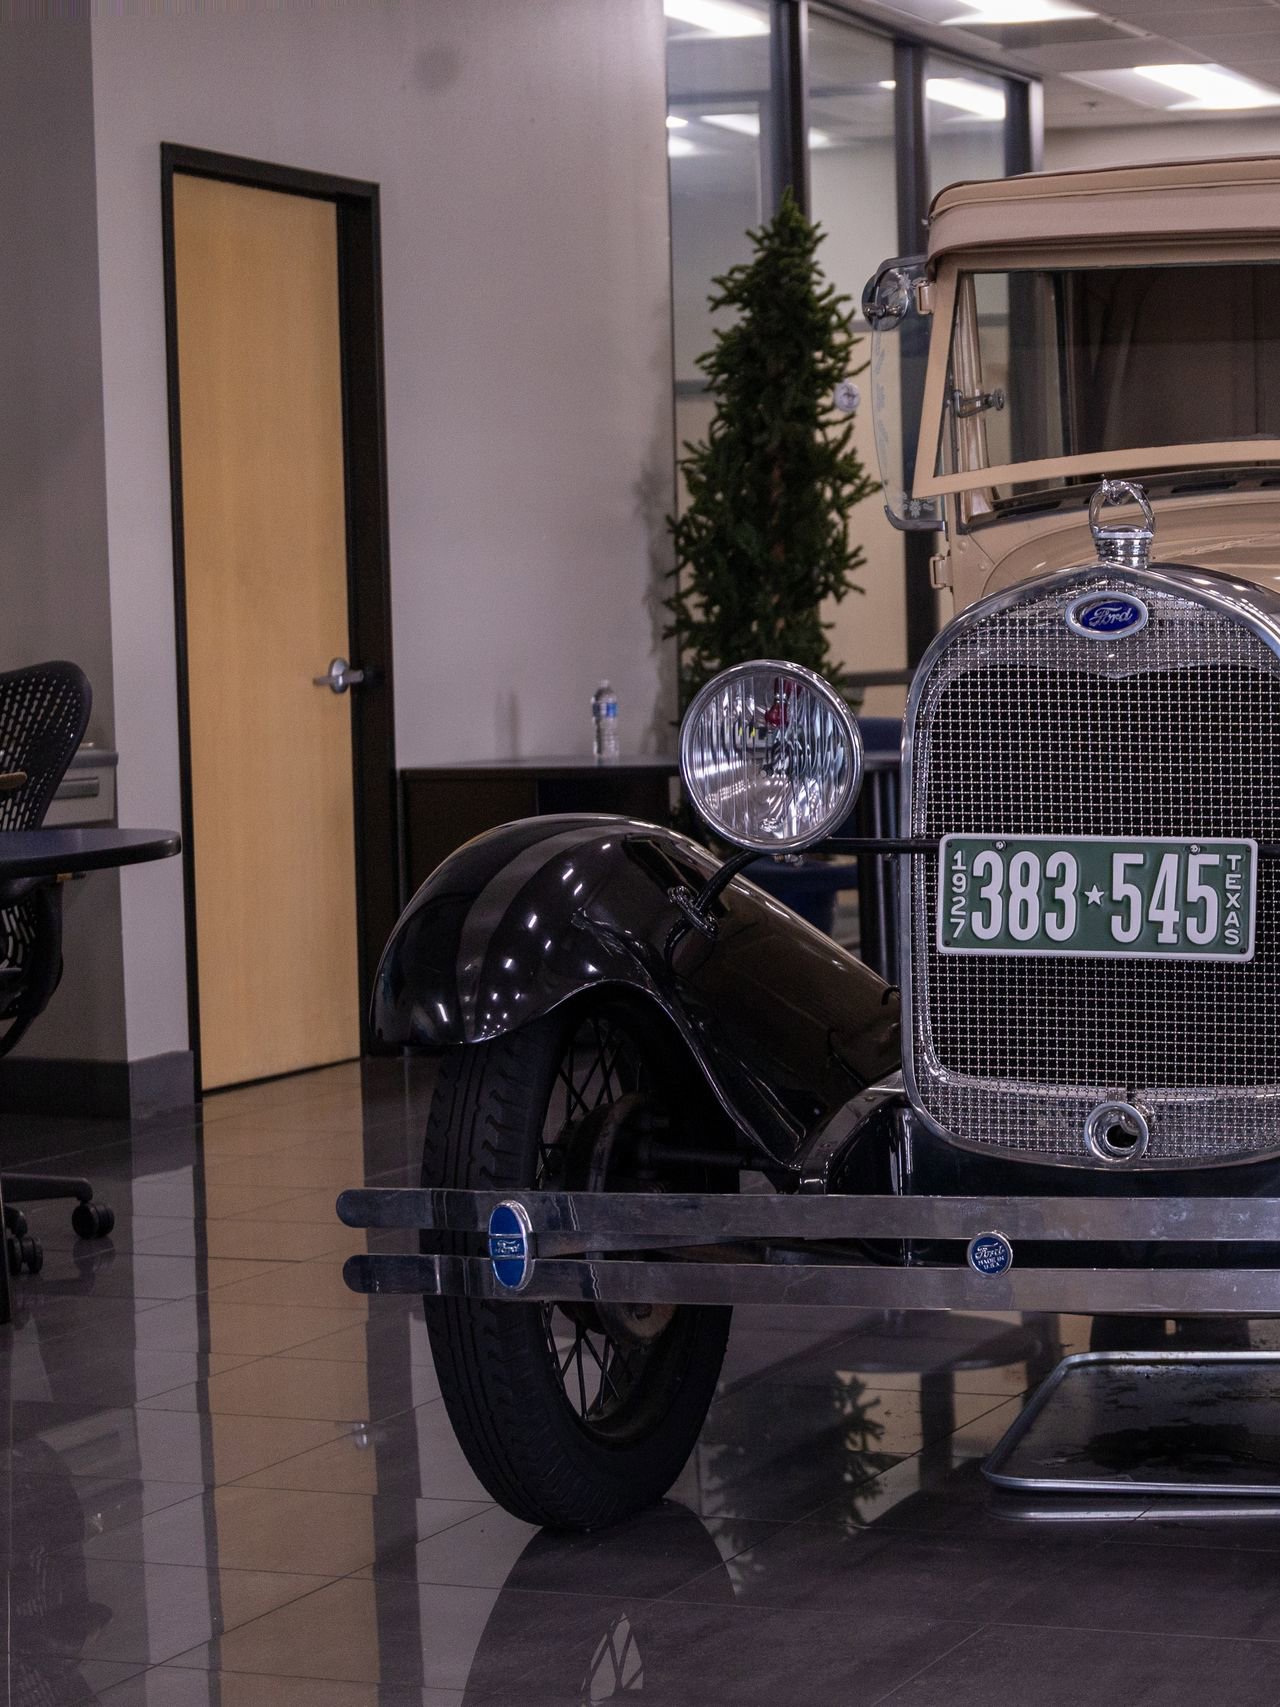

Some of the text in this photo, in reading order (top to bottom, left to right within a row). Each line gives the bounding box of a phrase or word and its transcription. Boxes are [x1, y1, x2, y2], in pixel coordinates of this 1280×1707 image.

[1088, 606, 1133, 627] Ford
[949, 850, 967, 939] 1927
[970, 850, 1221, 945] 383 545
[1224, 854, 1242, 945] TEXAS
[495, 1239, 520, 1253] Ford
[975, 1242, 1005, 1259] Ford
